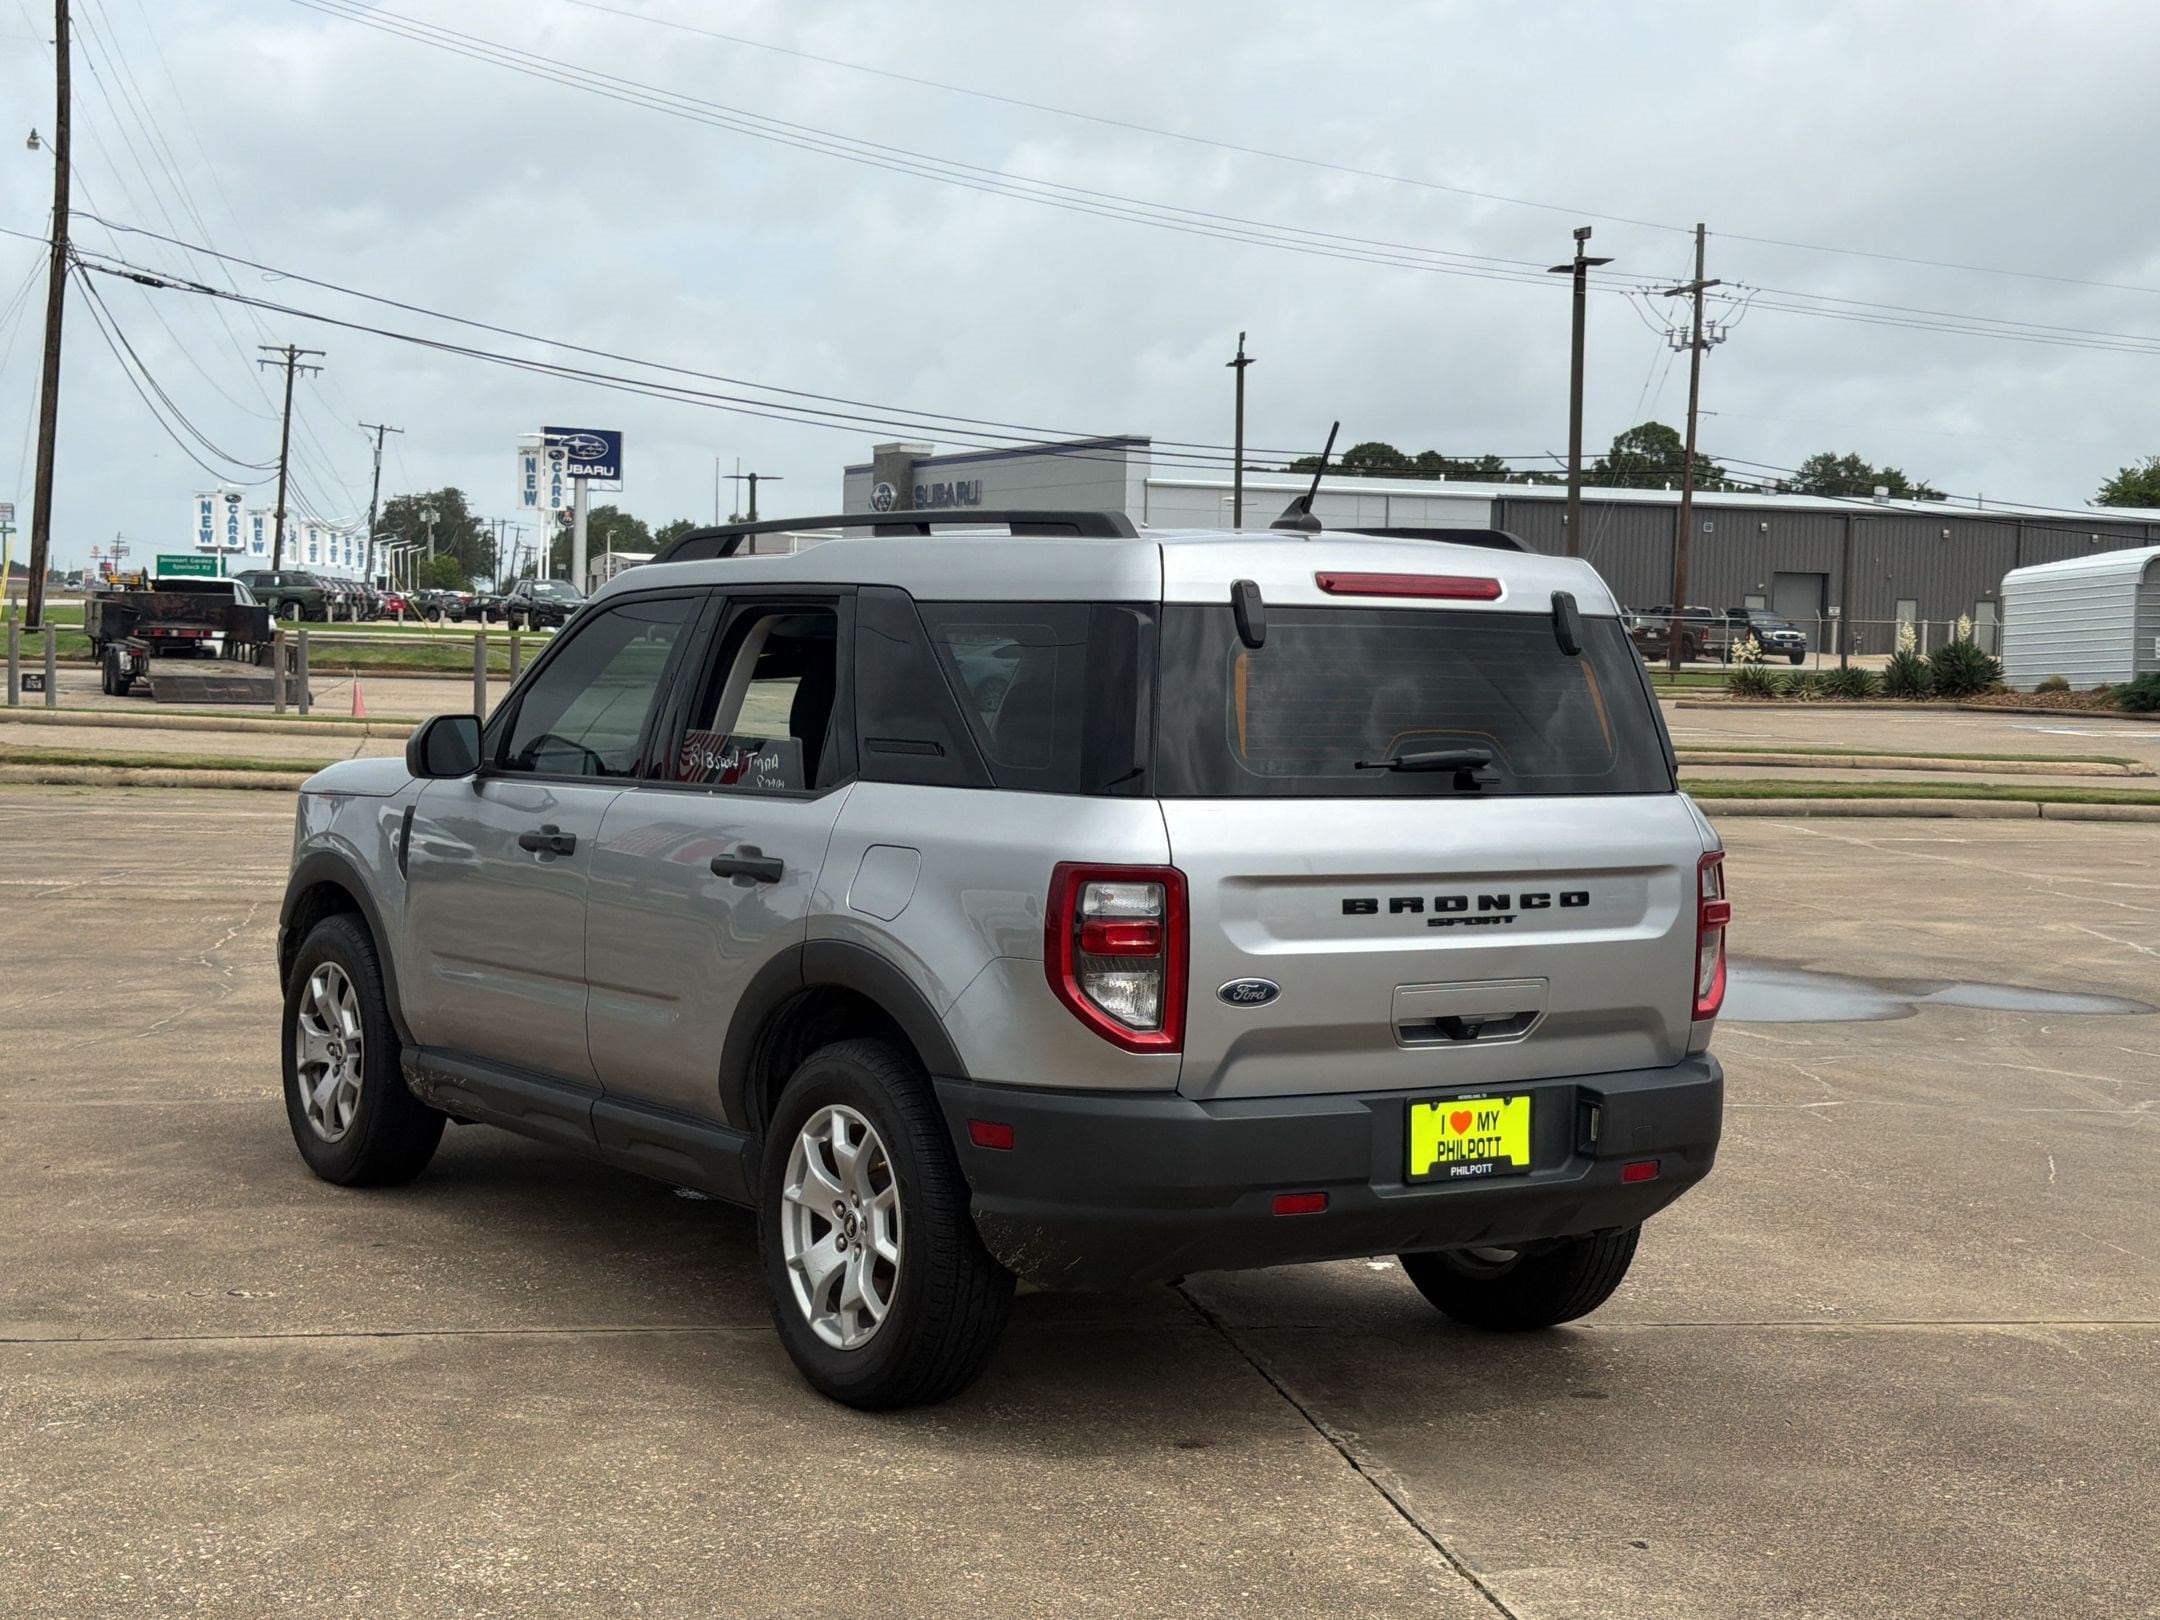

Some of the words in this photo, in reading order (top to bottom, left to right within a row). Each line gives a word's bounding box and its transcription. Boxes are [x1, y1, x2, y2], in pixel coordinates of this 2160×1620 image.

[523, 457, 537, 506] NEW
[566, 464, 614, 476] UBARU
[551, 461, 562, 508] CARS
[913, 480, 982, 507] SUBARU
[199, 500, 213, 543] NEW
[227, 504, 239, 545] CARS
[253, 517, 264, 553] NEW
[1342, 891, 1590, 915] BRONCO
[1427, 915, 1518, 927] SPORT
[1233, 984, 1267, 1000] Ford
[1442, 1115, 1445, 1134] I
[1477, 1110, 1500, 1132] MY
[1437, 1136, 1501, 1162] PHILPOTT
[1450, 1164, 1493, 1176] PHILPOTT
